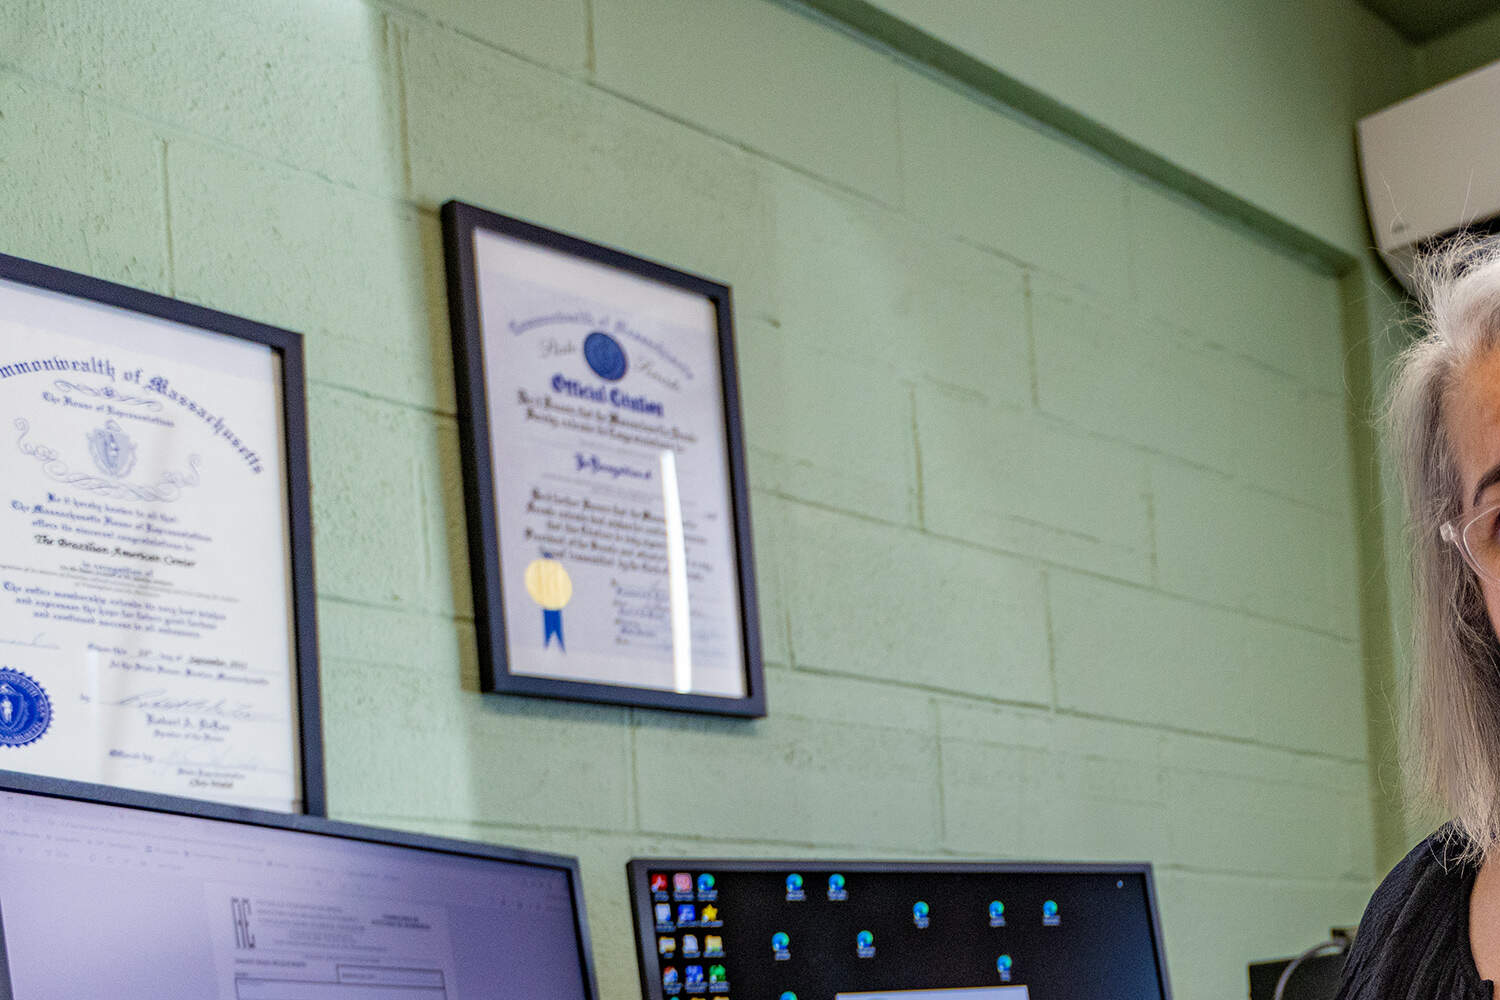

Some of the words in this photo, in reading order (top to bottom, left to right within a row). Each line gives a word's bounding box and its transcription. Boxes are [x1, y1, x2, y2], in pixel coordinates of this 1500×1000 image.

[551, 372, 608, 403] Official
[610, 386, 665, 418] Citation
[123, 368, 144, 384] of
[143, 376, 264, 474] Massachusetts
[34, 534, 54, 545] The
[57, 538, 109, 555] Brazilian
[110, 546, 161, 563] American
